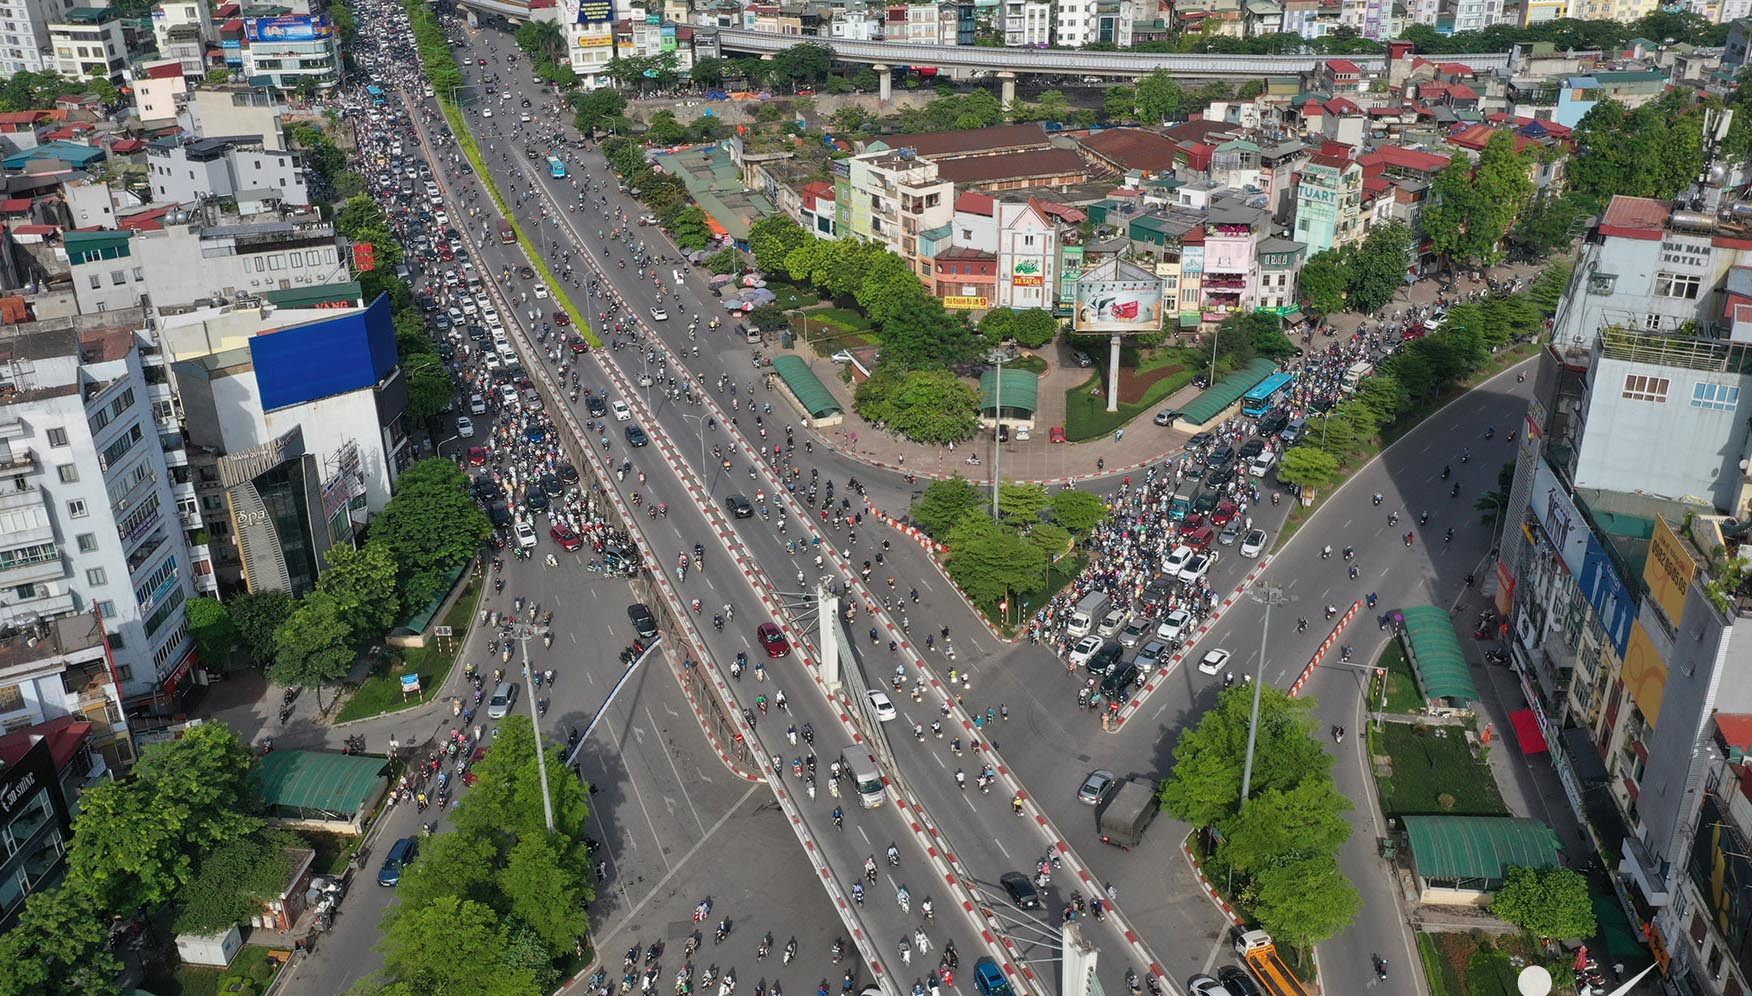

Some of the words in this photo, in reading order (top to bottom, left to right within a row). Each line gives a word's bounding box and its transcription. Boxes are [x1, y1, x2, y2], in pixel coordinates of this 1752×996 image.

[1298, 185, 1336, 202] TUART
[1686, 245, 1711, 255] NAM
[1664, 254, 1702, 266] HOTEL
[237, 509, 265, 527] Spa
